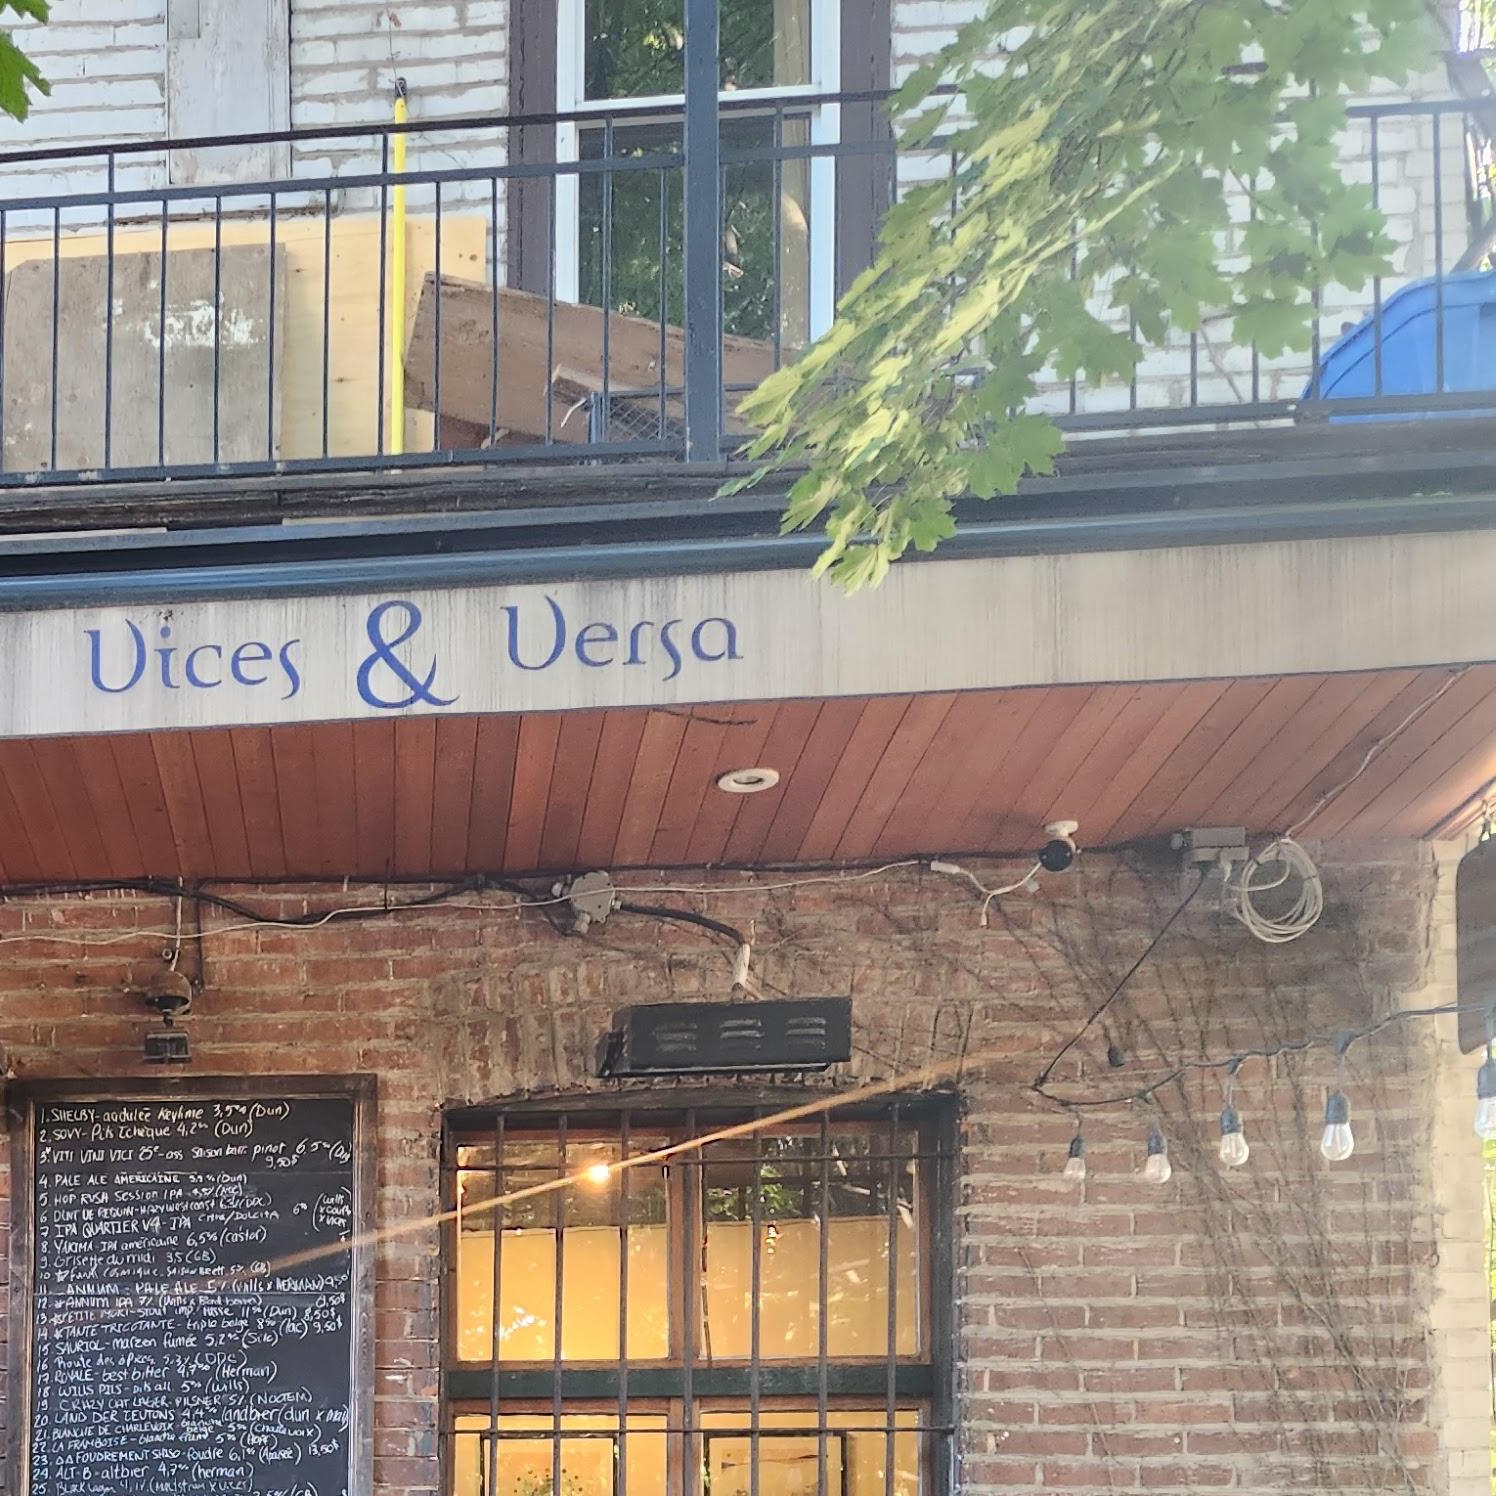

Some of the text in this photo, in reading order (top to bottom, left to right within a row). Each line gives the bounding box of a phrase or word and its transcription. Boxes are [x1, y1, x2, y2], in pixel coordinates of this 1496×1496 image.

[83, 594, 744, 709] Vices & Versa
[249, 1102, 290, 1122] (Dun)
[215, 1120, 253, 1138] (Dun)
[39, 1173, 247, 1189] 4. PALE ALE (Dun)
[55, 1188, 183, 1206] HOP RUSH IPA
[55, 1215, 192, 1238] IPA QUARTIER IPA
[100, 1241, 117, 1252] IPA
[106, 1253, 124, 1265] du
[136, 1282, 170, 1294] PALE
[174, 1281, 199, 1294] ALE
[264, 1305, 297, 1320] (Dun)
[54, 1357, 92, 1368] Route
[96, 1355, 113, 1366] des
[102, 1369, 129, 1382] best
[131, 1366, 170, 1380] bitter
[215, 1361, 277, 1383] (Herman)
[99, 1384, 122, 1395] PILS
[108, 1398, 130, 1409] CAT
[54, 1412, 88, 1424] LAND
[92, 1410, 119, 1423] DER
[124, 1409, 175, 1421] TEUTONS
[98, 1424, 112, 1435] DE
[51, 1442, 64, 1453] LA
[67, 1437, 128, 1451] FRAMBOISE
[75, 1450, 150, 1464] FOUDREMENT
[187, 1446, 223, 1461] foudre
[101, 1465, 150, 1479] altbier
[191, 1462, 254, 1482] (herman)
